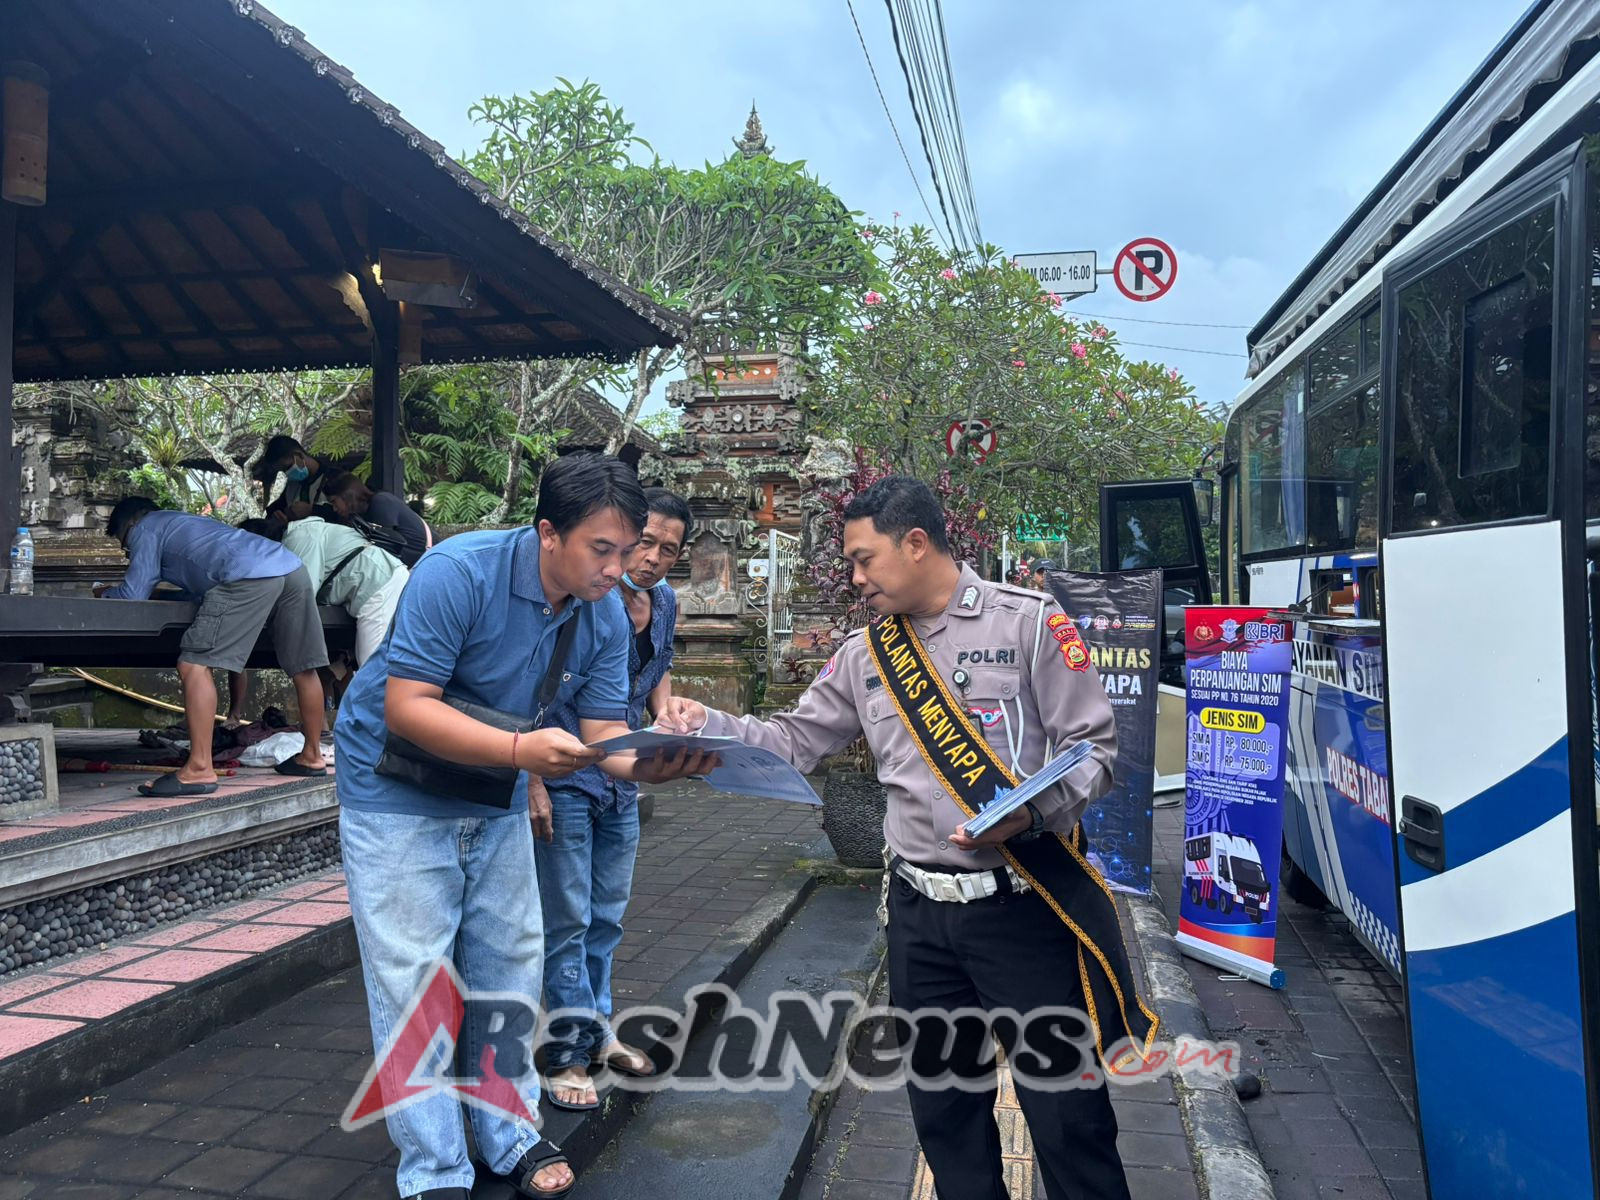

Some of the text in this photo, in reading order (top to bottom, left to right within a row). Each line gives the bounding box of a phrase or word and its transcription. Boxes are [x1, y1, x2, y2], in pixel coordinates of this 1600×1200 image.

[1039, 266, 1061, 282] 06.00
[1069, 265, 1091, 280] 16.00
[1260, 623, 1285, 640] BRI
[957, 649, 1015, 665] POLRI
[1090, 647, 1151, 669] ANTAS
[1221, 651, 1248, 670] BIAYA
[1292, 640, 1348, 688] AYANAN
[1100, 674, 1142, 695] APA
[1190, 669, 1282, 693] PERPANJANGAN SIM
[877, 615, 987, 787] POLANTAS MENYAPA
[1191, 689, 1210, 700] SESUAI
[1211, 690, 1220, 700] PP
[1231, 692, 1239, 703] 76
[1240, 694, 1260, 704] TAHUN
[1260, 695, 1279, 706] 2020
[1205, 710, 1258, 729] JENIS SIM
[1191, 732, 1204, 744] SIM
[1204, 734, 1210, 745] A
[1191, 750, 1203, 762] SIM
[1204, 753, 1210, 764] C
[1326, 746, 1360, 804] POLRES
